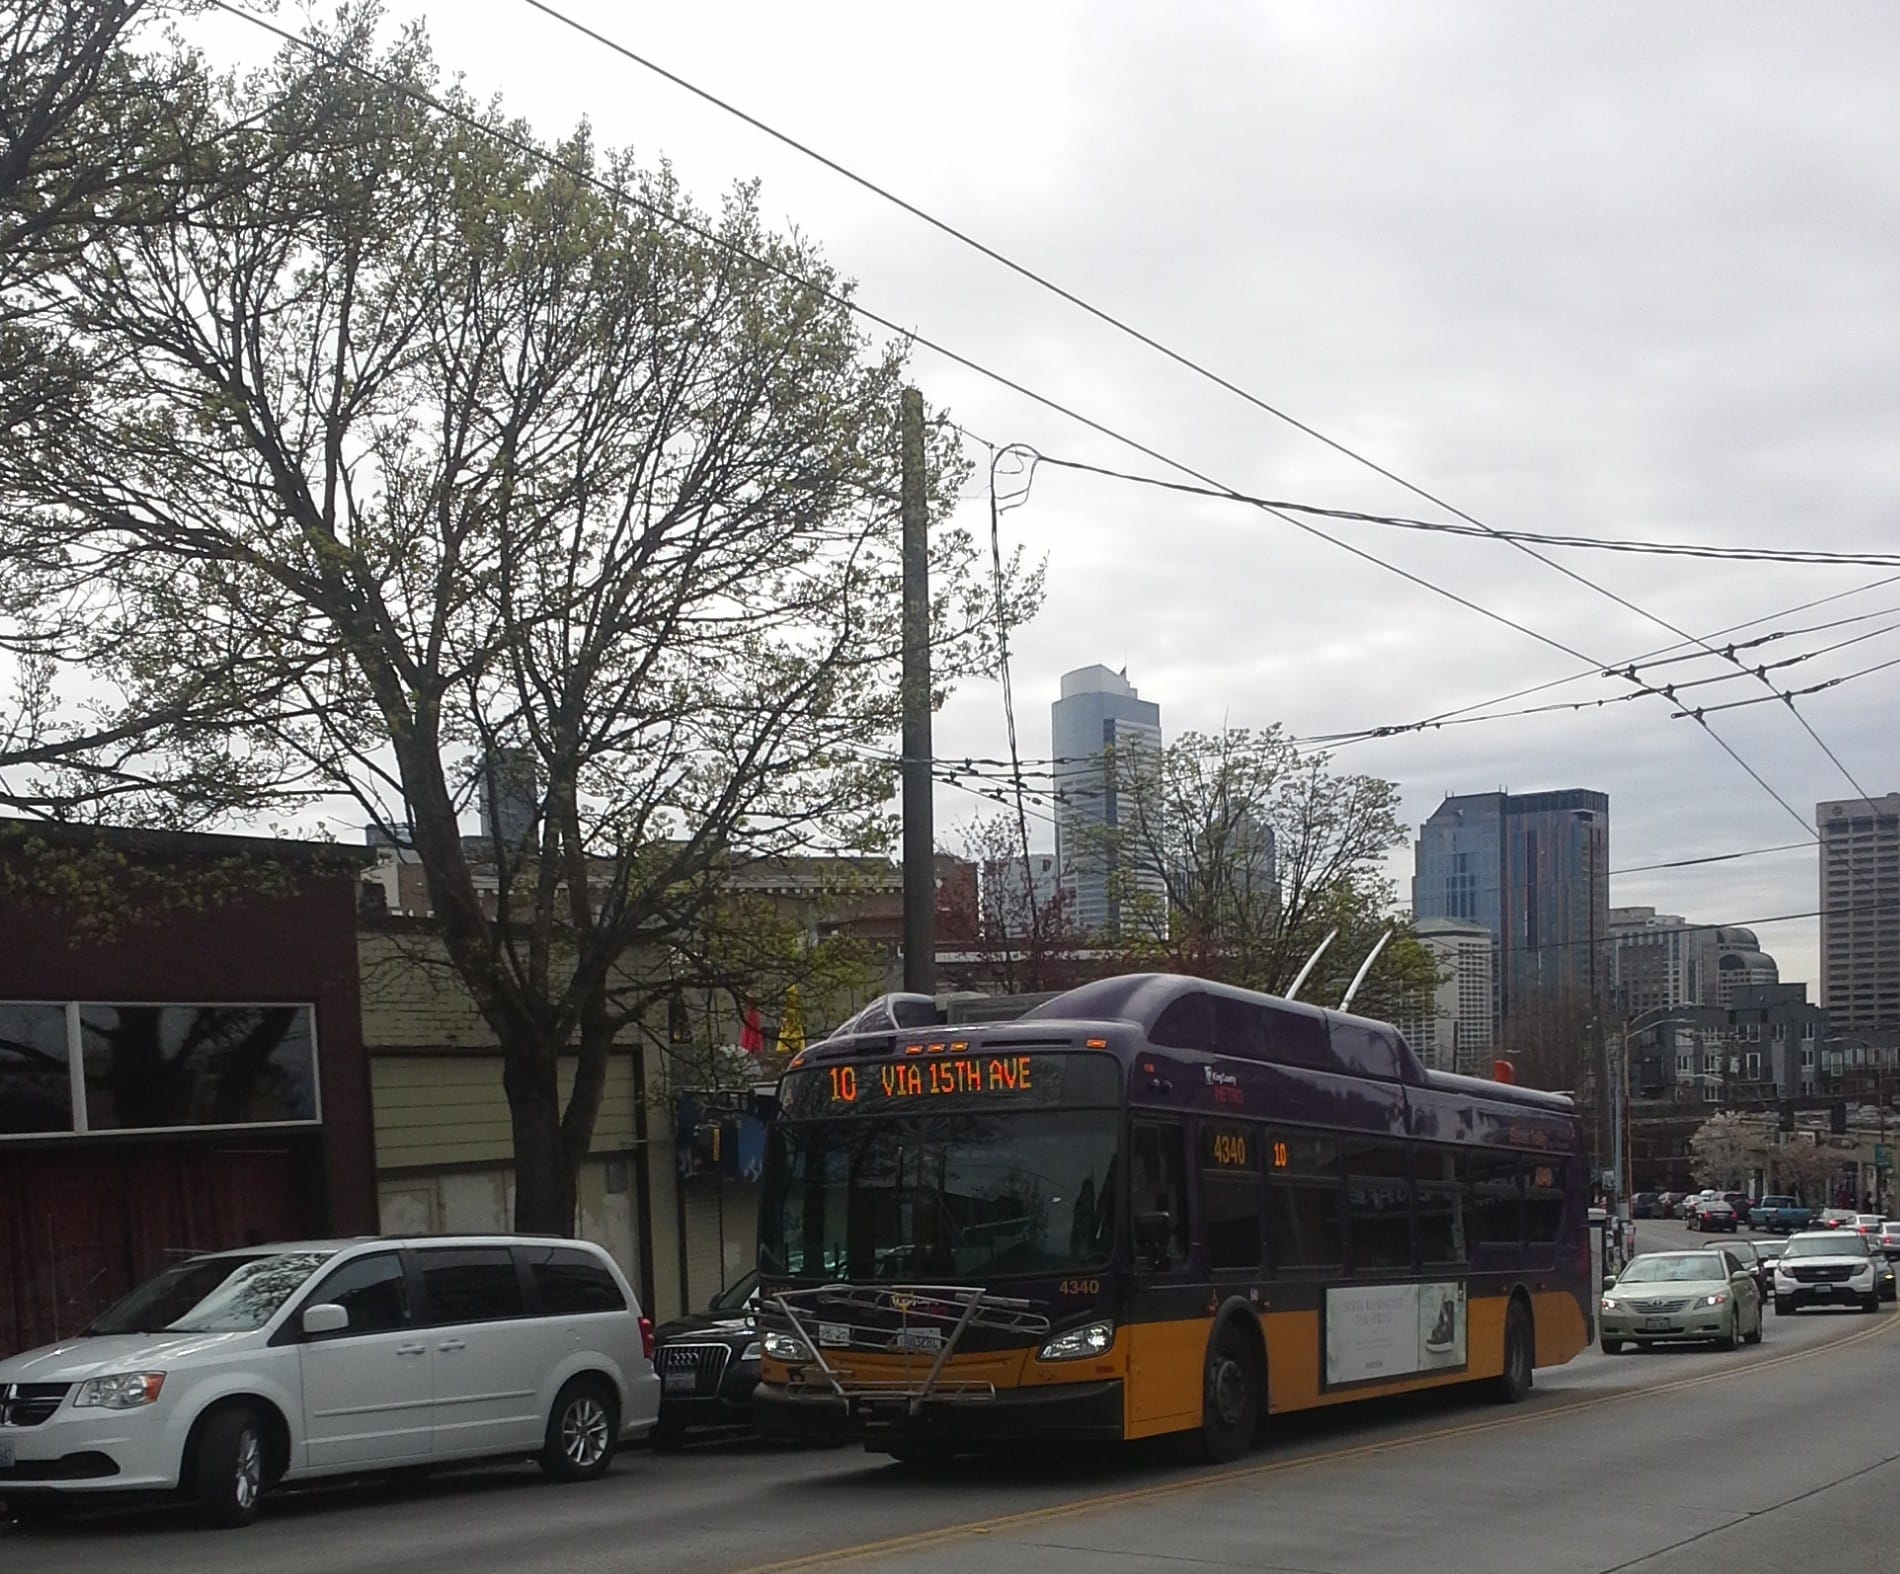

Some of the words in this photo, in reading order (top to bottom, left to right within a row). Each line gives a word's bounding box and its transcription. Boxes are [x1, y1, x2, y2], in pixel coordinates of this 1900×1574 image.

[829, 1066, 857, 1101] 10
[882, 1064, 921, 1097] VIA
[929, 1061, 980, 1094] 15TH
[989, 1056, 1031, 1090] AVE
[1214, 1135, 1246, 1165] 4340
[1273, 1142, 1287, 1167] 10
[1059, 1279, 1100, 1295] 4340
